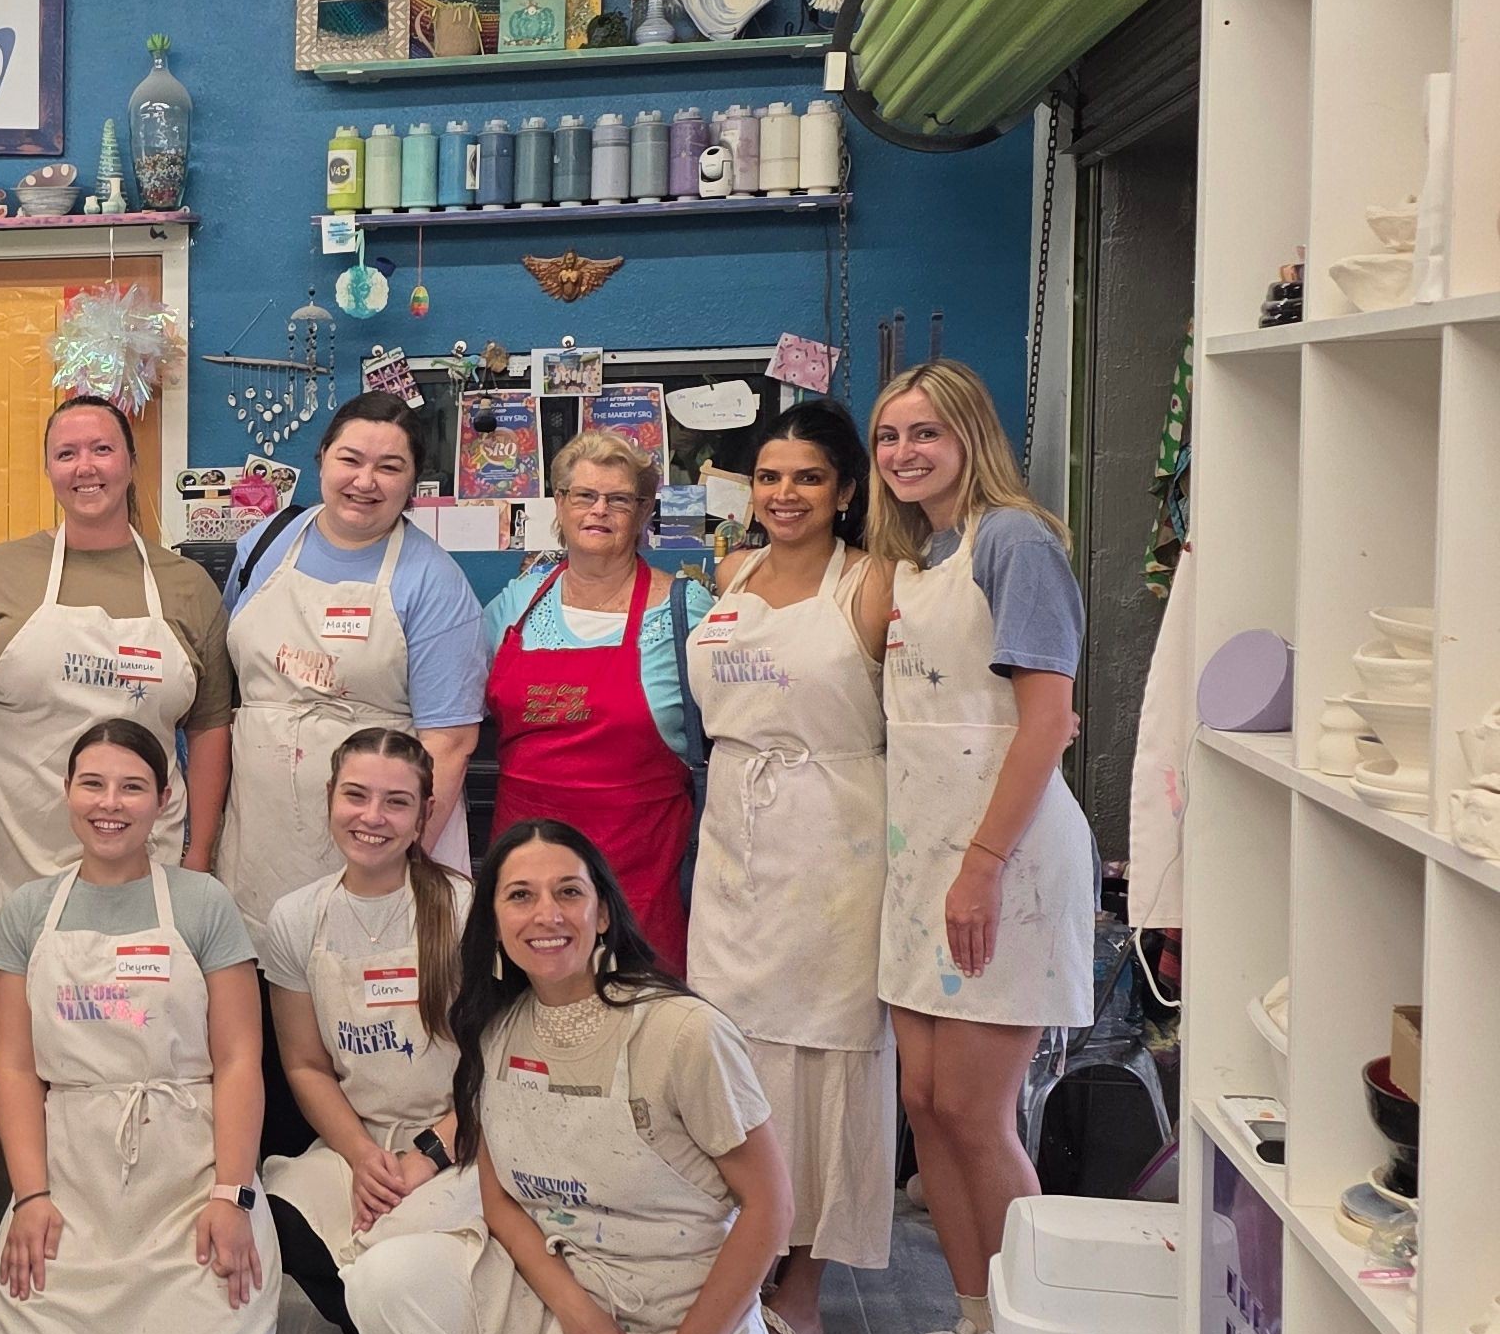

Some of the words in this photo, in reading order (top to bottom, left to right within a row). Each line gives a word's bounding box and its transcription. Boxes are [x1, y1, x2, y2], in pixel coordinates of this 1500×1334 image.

[513, 414, 528, 423] SRQ
[607, 411, 638, 419] MAKERY
[637, 410, 653, 419] SRQ
[484, 442, 518, 459] SRQ
[326, 621, 361, 634] Maggie
[64, 652, 118, 672] MYSTIC
[711, 650, 776, 666] MAGICAL
[711, 663, 777, 683] MAKER
[56, 984, 131, 1001] MATURE
